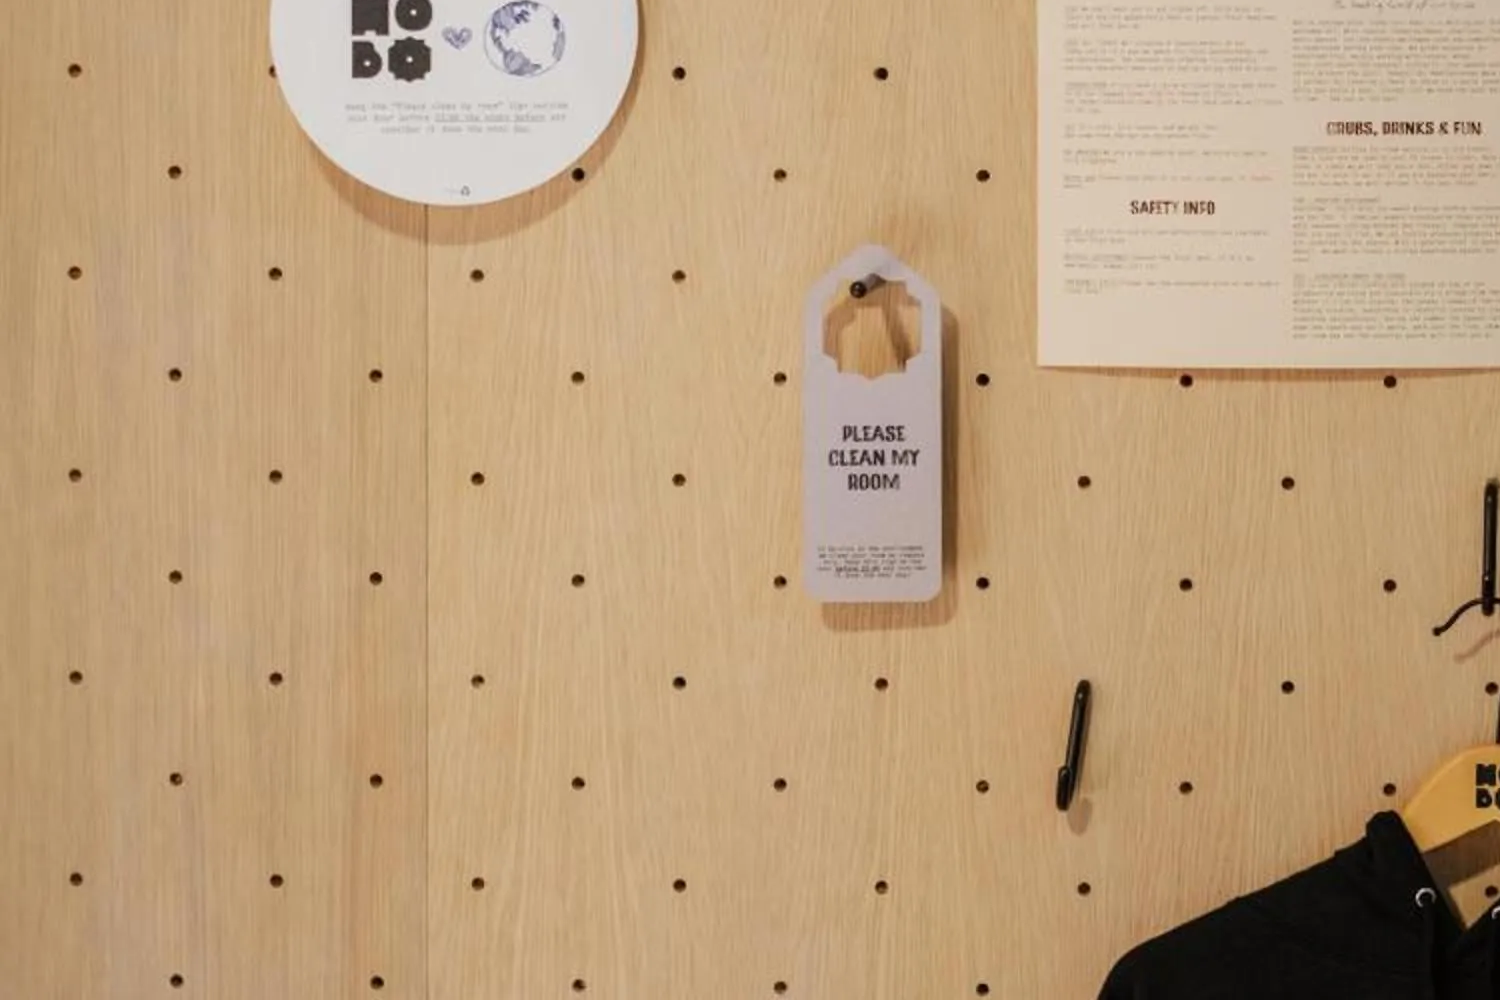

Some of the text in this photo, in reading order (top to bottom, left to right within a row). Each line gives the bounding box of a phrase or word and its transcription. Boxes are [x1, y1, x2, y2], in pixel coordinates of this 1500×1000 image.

[1382, 121, 1435, 136] DRINKS
[1438, 121, 1449, 135] &
[1453, 121, 1482, 136] FUN
[1130, 199, 1216, 216] SAFETY INFO
[842, 424, 906, 443] PLEASE
[828, 449, 921, 467] CLEAN MY
[847, 473, 900, 491] ROOM
